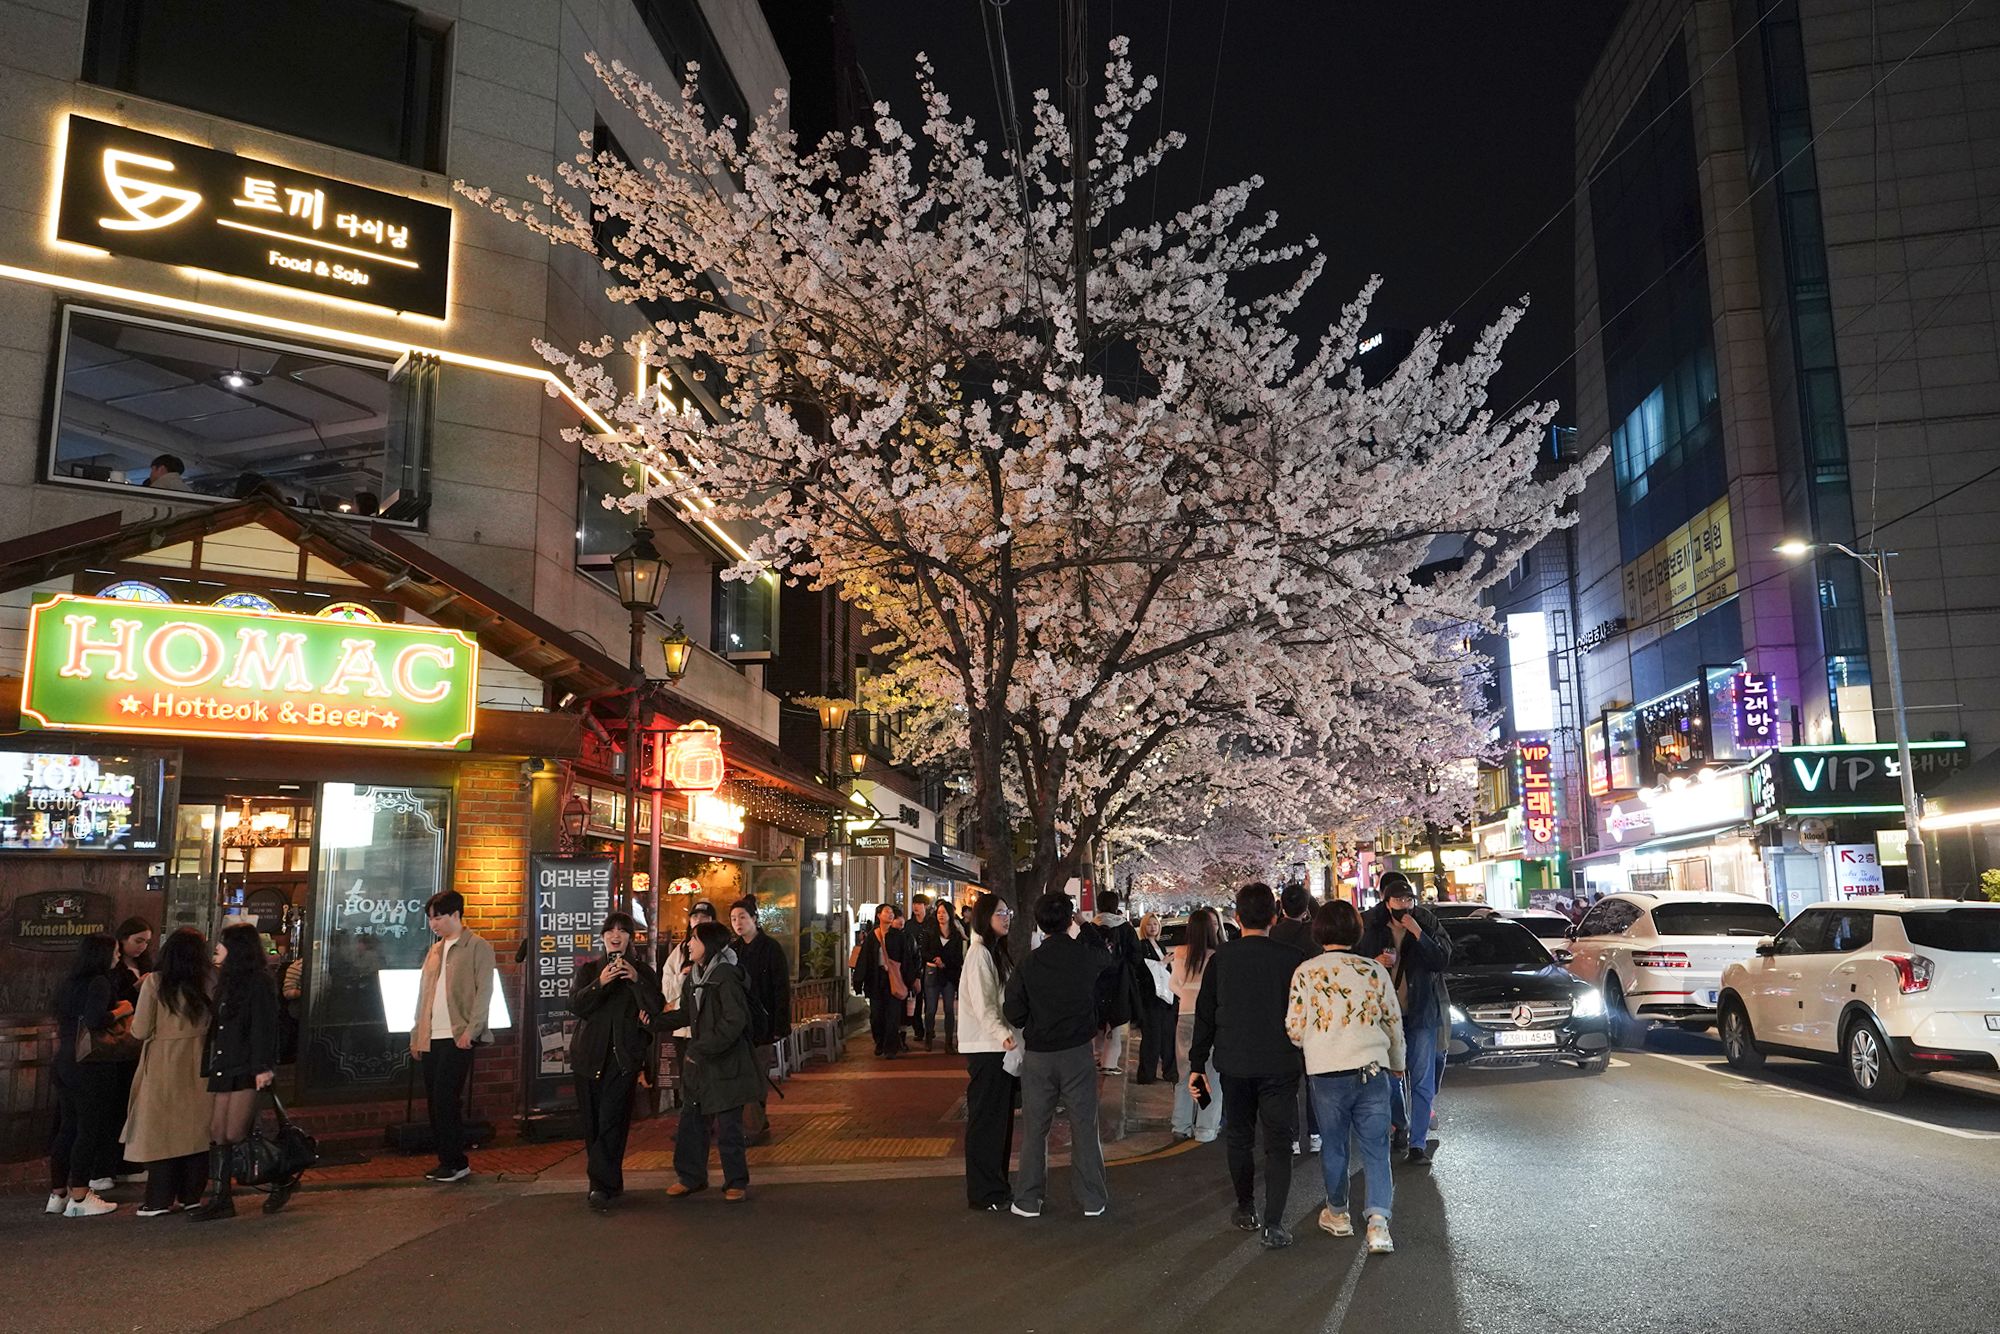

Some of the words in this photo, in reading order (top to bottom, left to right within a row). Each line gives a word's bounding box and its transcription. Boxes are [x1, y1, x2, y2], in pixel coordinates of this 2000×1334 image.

[233, 177, 325, 230] 토끼
[336, 213, 409, 249] 다이닝
[268, 250, 313, 277] Food
[314, 261, 331, 278] &
[332, 264, 370, 287] Soju
[58, 613, 456, 704] HOMAC
[151, 692, 270, 723] Hotteok
[280, 702, 299, 725] &
[308, 703, 371, 728] Beer
[1743, 674, 1774, 736] 노래방
[1522, 746, 1549, 761] VIP
[1743, 737, 1761, 746] VIP
[1793, 755, 1875, 792] VIP
[1524, 765, 1555, 843] 노래방
[539, 868, 610, 888] 여러분은
[540, 912, 609, 931] 대한민국
